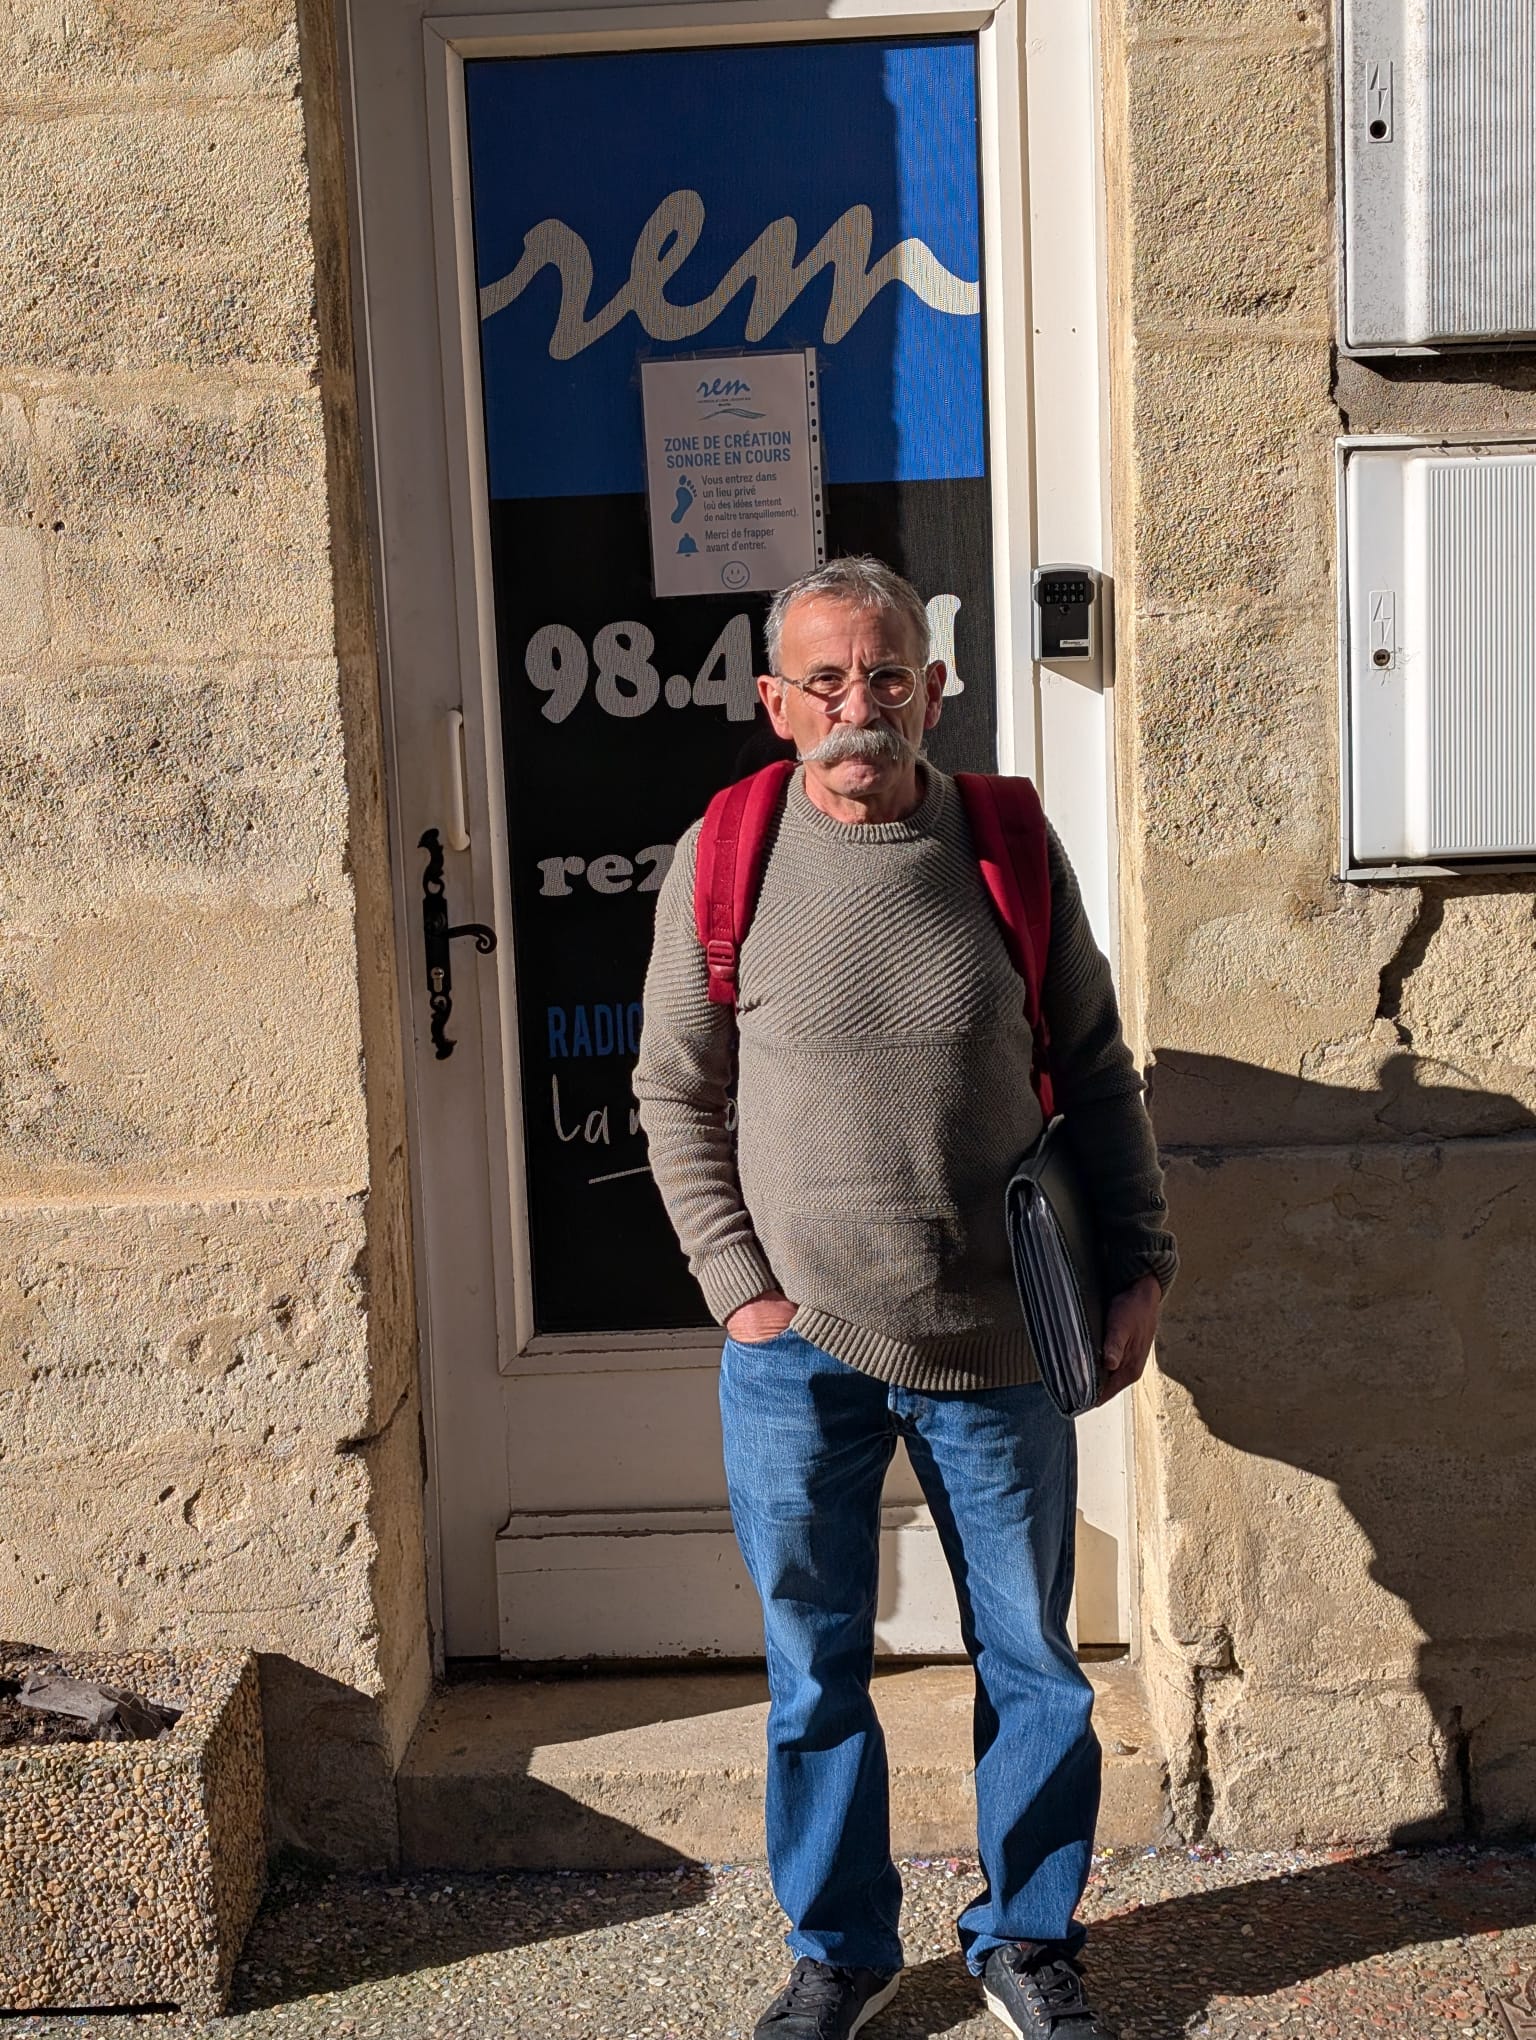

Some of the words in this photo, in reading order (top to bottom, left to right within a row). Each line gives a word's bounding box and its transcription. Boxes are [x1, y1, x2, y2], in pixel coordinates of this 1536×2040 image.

[480, 189, 979, 361] rem
[696, 378, 751, 398] rem
[664, 437, 700, 452] ZONE
[704, 435, 720, 449] DE
[725, 431, 791, 449] CRÉATION
[667, 452, 721, 469] SONORE
[725, 451, 742, 465] EN
[746, 448, 791, 464] COURS
[702, 475, 723, 486] Vous
[725, 474, 753, 484] entrez
[756, 473, 777, 482] dans
[703, 490, 714, 498] un
[716, 489, 731, 497] lieu
[735, 486, 756, 498] privé
[704, 501, 715, 511] (où
[718, 501, 731, 509] des
[733, 500, 753, 508] idées
[755, 499, 782, 507] tentent
[704, 514, 713, 522] de
[715, 513, 737, 521] naître
[739, 509, 799, 522] tranquillement).
[706, 530, 729, 540] Merci
[731, 530, 741, 538] de
[744, 528, 775, 539] frapper
[706, 543, 729, 552] avant
[732, 541, 767, 551] d'entrer.
[525, 613, 760, 724] 98.4
